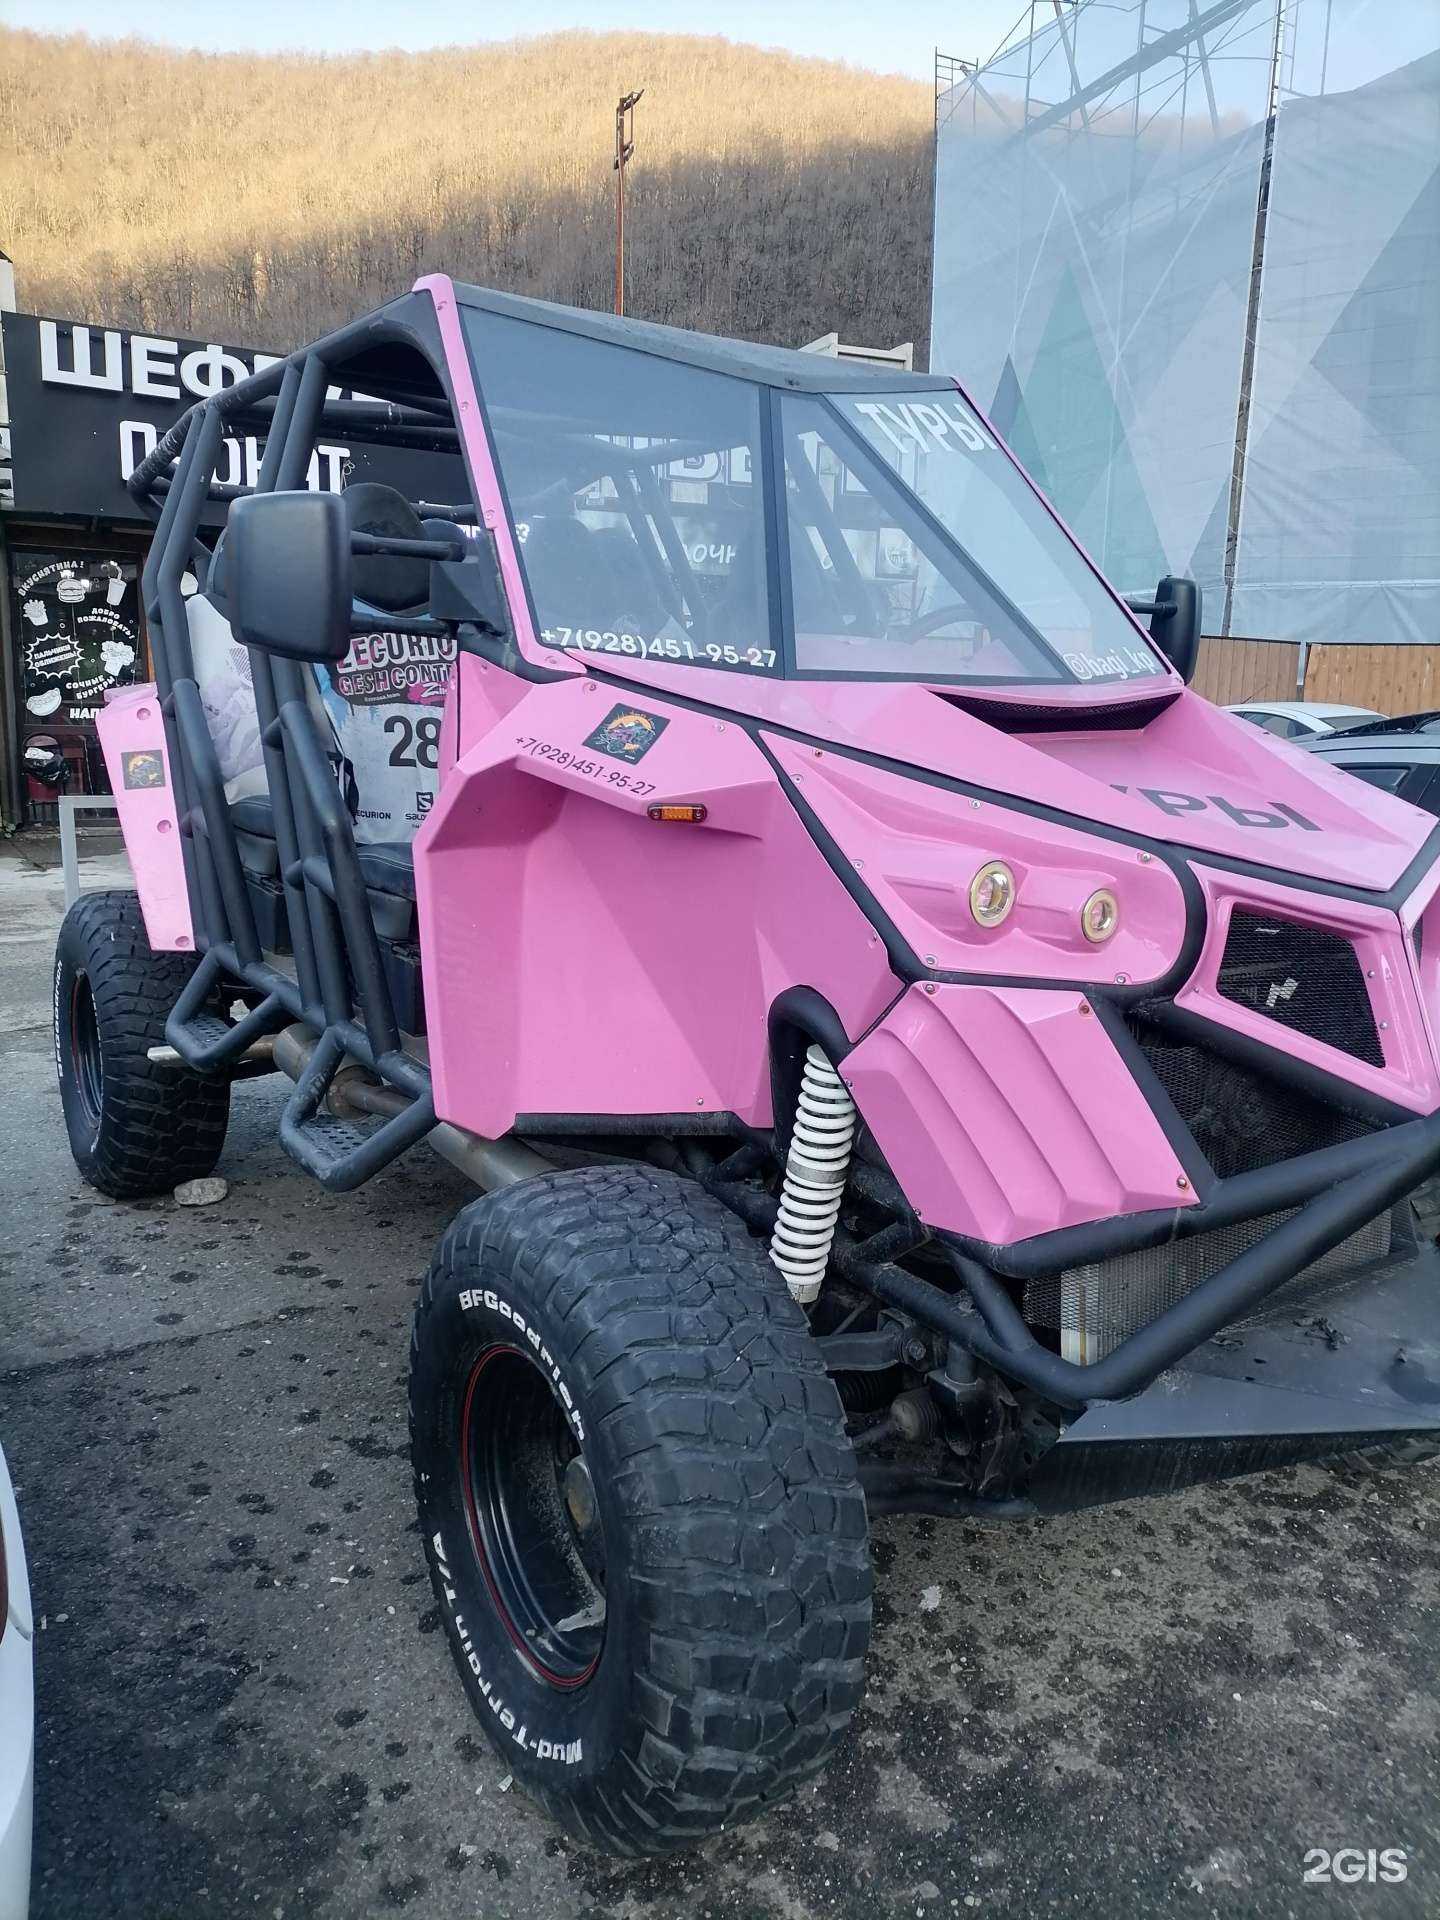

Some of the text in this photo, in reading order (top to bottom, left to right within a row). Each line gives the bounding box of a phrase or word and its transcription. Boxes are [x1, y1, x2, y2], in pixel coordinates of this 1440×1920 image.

[855, 403, 999, 454] ТУРЫ
[77, 615, 136, 640] ПОЖАЛОВАТЬ!
[91, 607, 121, 620] ДОБРО
[337, 633, 458, 673] ECURIO
[541, 627, 777, 668] +7(928)451-95-27
[66, 675, 105, 689] СОЧНЫЕ
[76, 676, 116, 700] БУРГЕРЫ
[338, 670, 391, 696] GESH
[69, 707, 103, 719] НАП
[384, 715, 442, 769] 28
[515, 736, 656, 798] +7(928)451-95-27
[352, 809, 392, 820] ECURION
[1110, 784, 1324, 832] РЫ
[458, 1288, 585, 1441] BFGoodrich
[455, 1614, 583, 1764] Mud-Terrain
